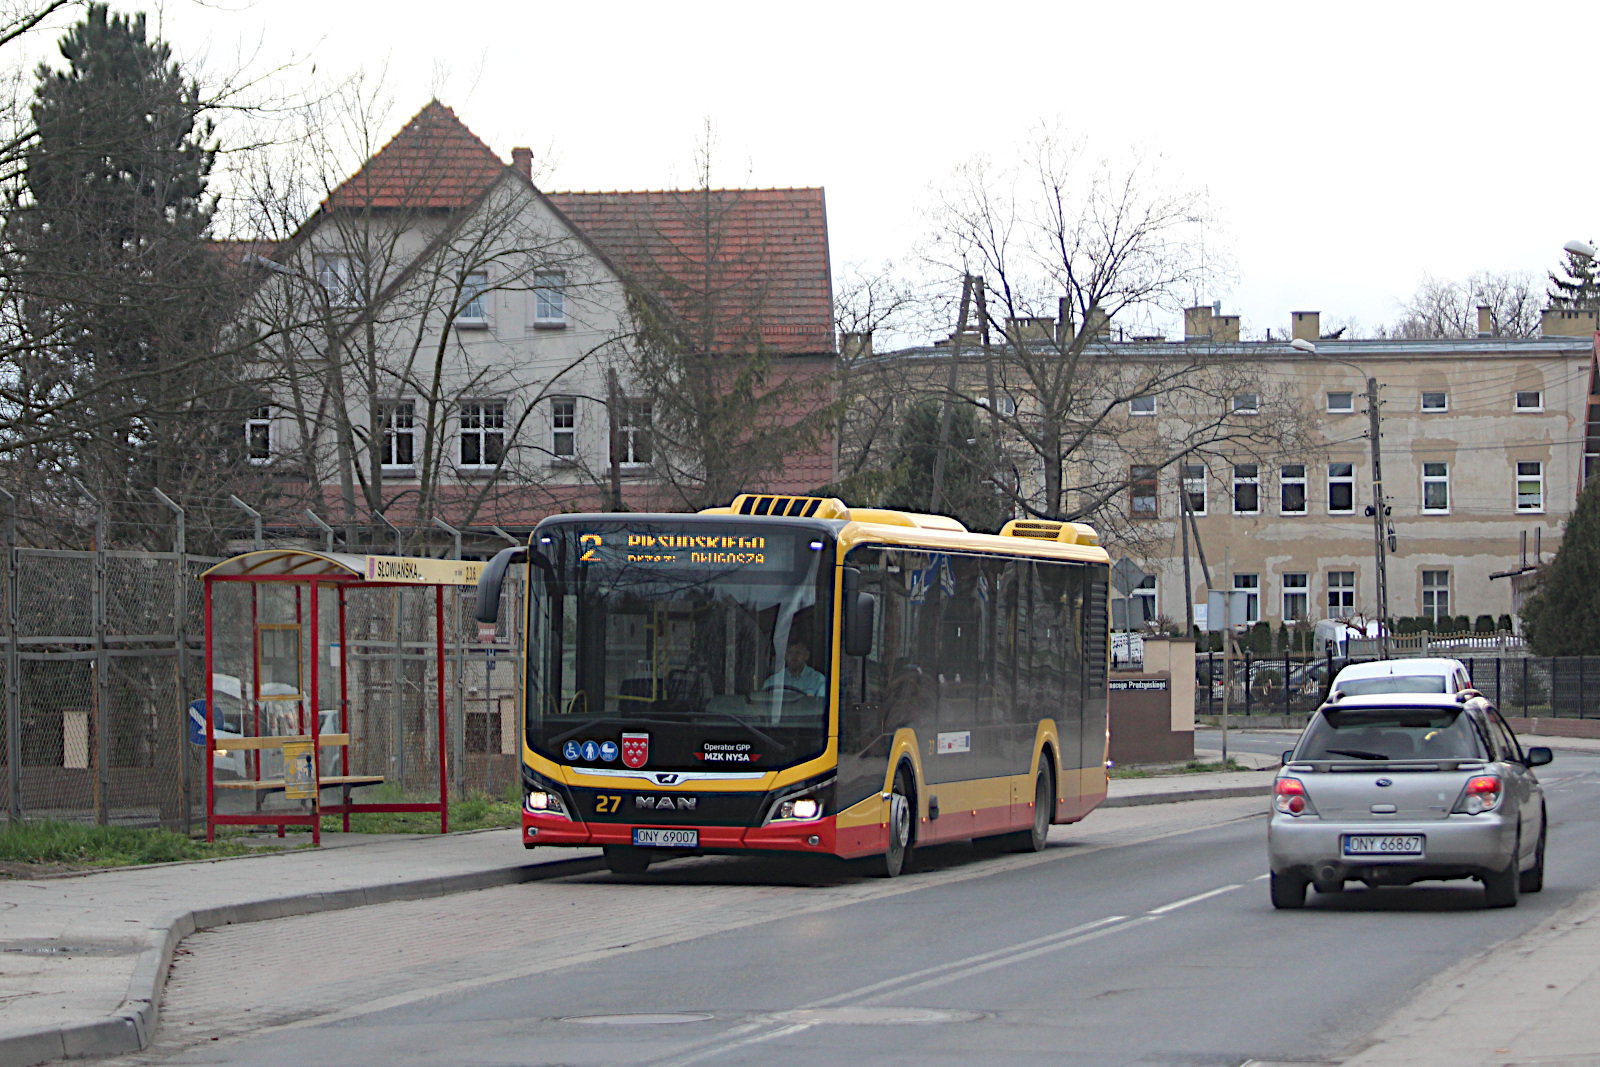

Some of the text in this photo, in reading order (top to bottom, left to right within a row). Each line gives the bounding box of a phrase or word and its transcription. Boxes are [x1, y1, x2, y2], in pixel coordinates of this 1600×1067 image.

[580, 533, 603, 561] 2
[377, 560, 418, 579] SŁOWIAŃSKA
[704, 743, 751, 752] Operator GPP
[704, 752, 750, 762] MZK NYSA
[596, 795, 622, 813] 27
[635, 796, 697, 810] MAN
[638, 831, 696, 843] ONY 69007
[1351, 837, 1419, 851] ONY 66867
